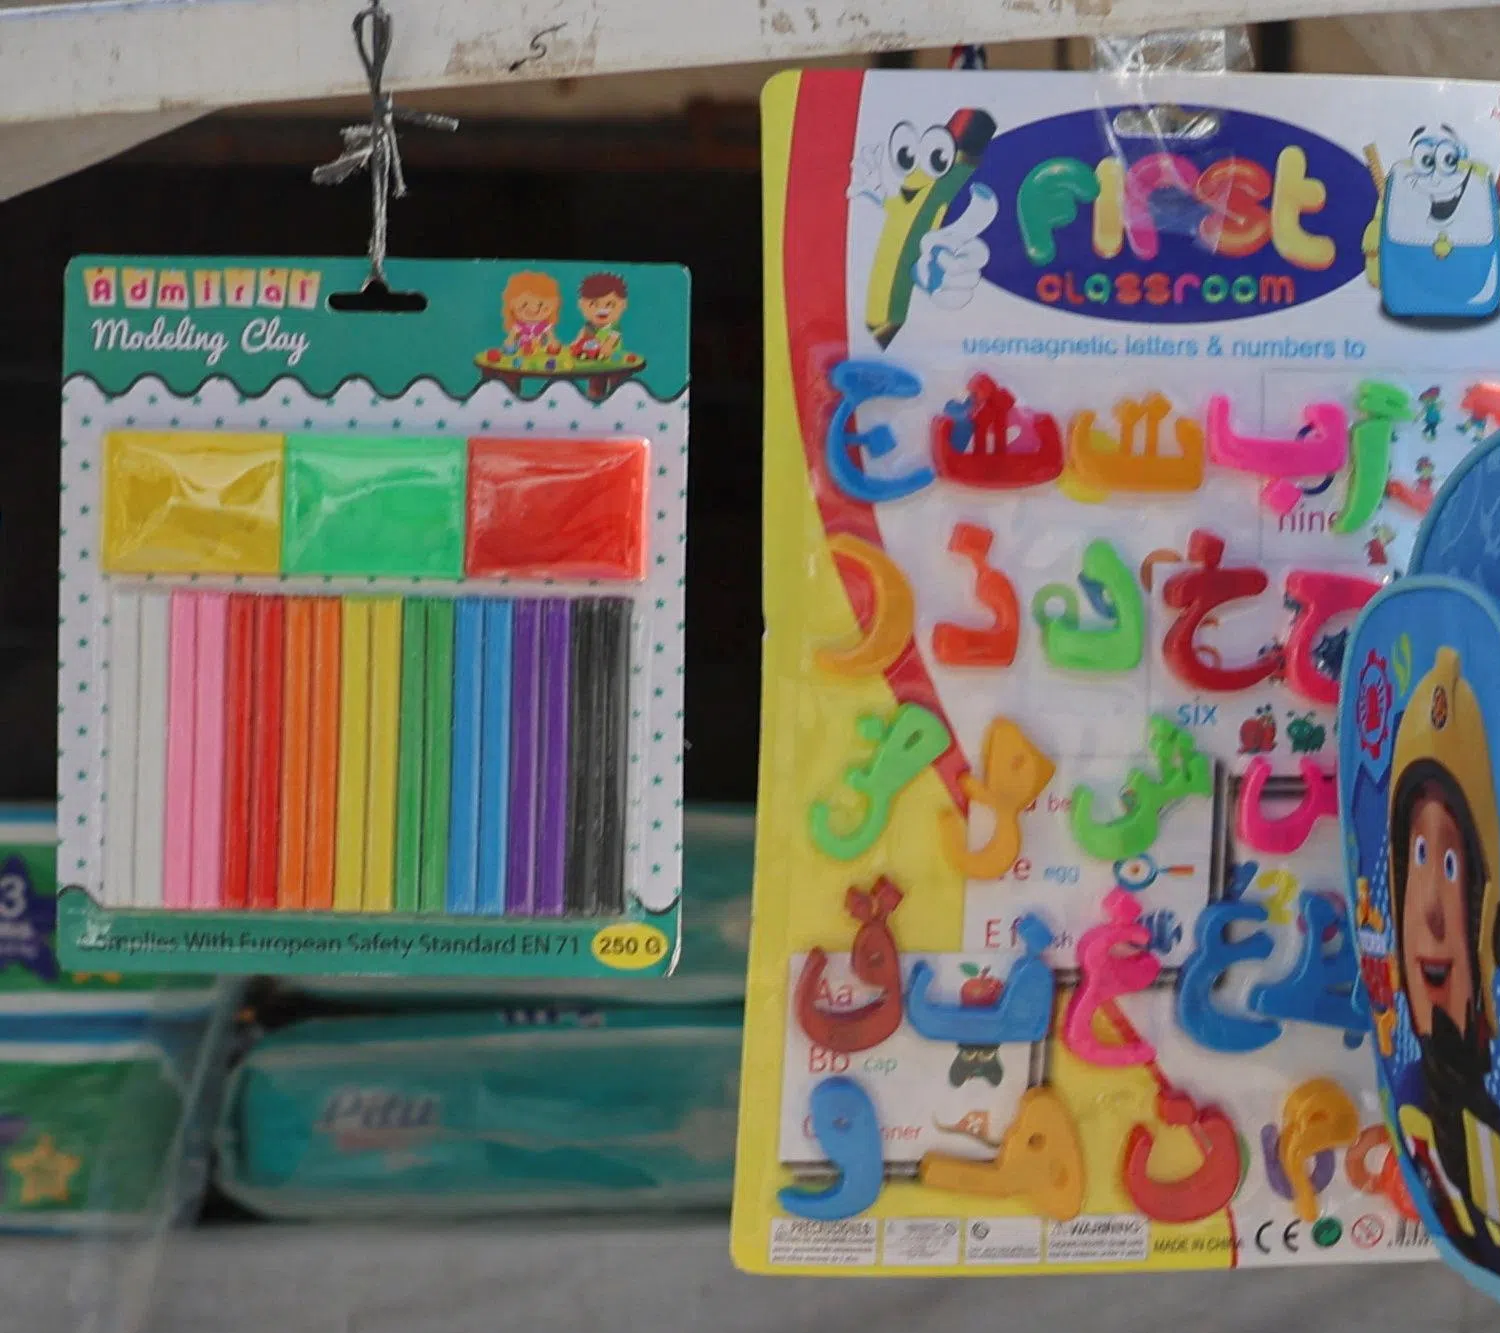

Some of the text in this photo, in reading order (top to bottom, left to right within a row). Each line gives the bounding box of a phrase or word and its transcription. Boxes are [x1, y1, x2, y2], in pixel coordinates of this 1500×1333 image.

[91, 275, 314, 304] Admiral
[1036, 270, 1295, 306] classroom
[91, 315, 310, 367] Modeling Clay
[1125, 335, 1199, 358] letters
[1205, 336, 1225, 358] &
[1231, 336, 1337, 359] numbers
[1342, 338, 1368, 358] to
[1177, 702, 1218, 727] six
[182, 933, 237, 953] With
[239, 934, 343, 958] European
[347, 933, 415, 958] Safety
[417, 934, 516, 957] Standard
[521, 935, 550, 956] EN
[552, 936, 581, 956] 71
[599, 936, 639, 957] 250
